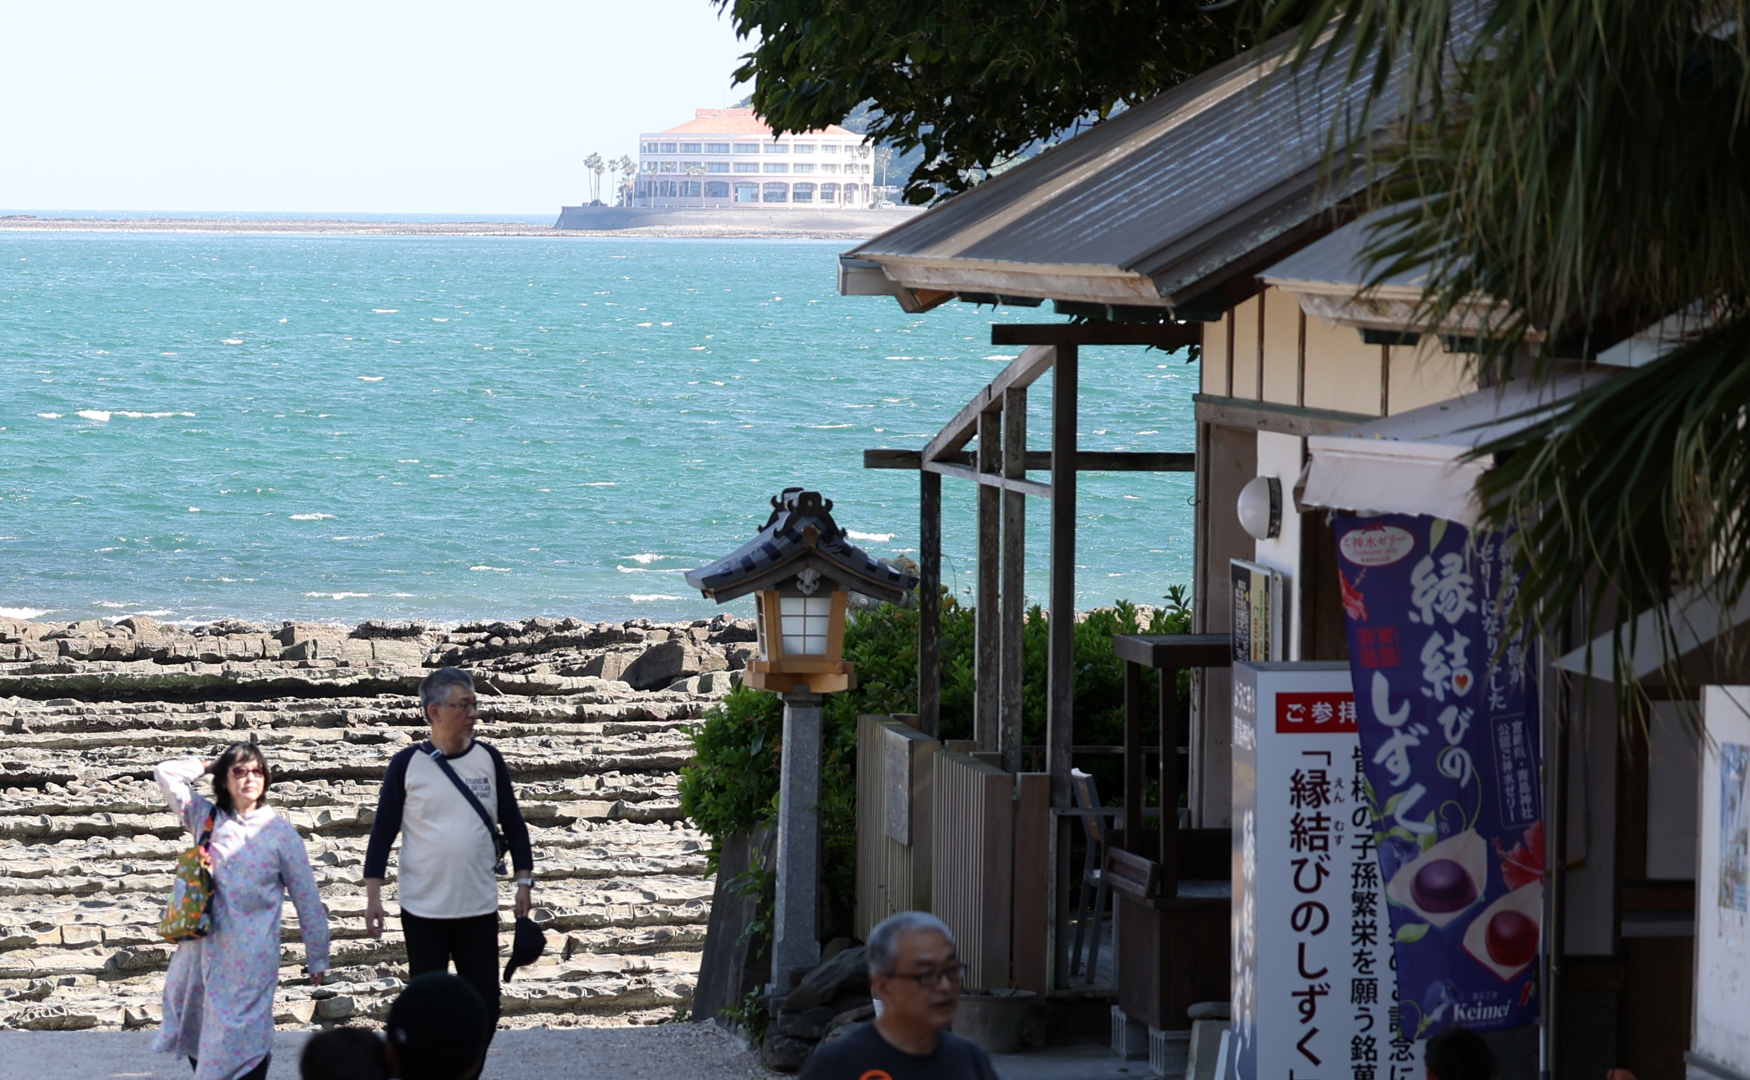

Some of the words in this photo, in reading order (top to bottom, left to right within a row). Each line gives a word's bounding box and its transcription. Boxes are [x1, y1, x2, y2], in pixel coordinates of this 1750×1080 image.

[1408, 552, 1480, 787] 縁結びの
[1334, 777, 1346, 804] えん
[1371, 669, 1433, 835] しずく
[1453, 999, 1512, 1022] Keimei
